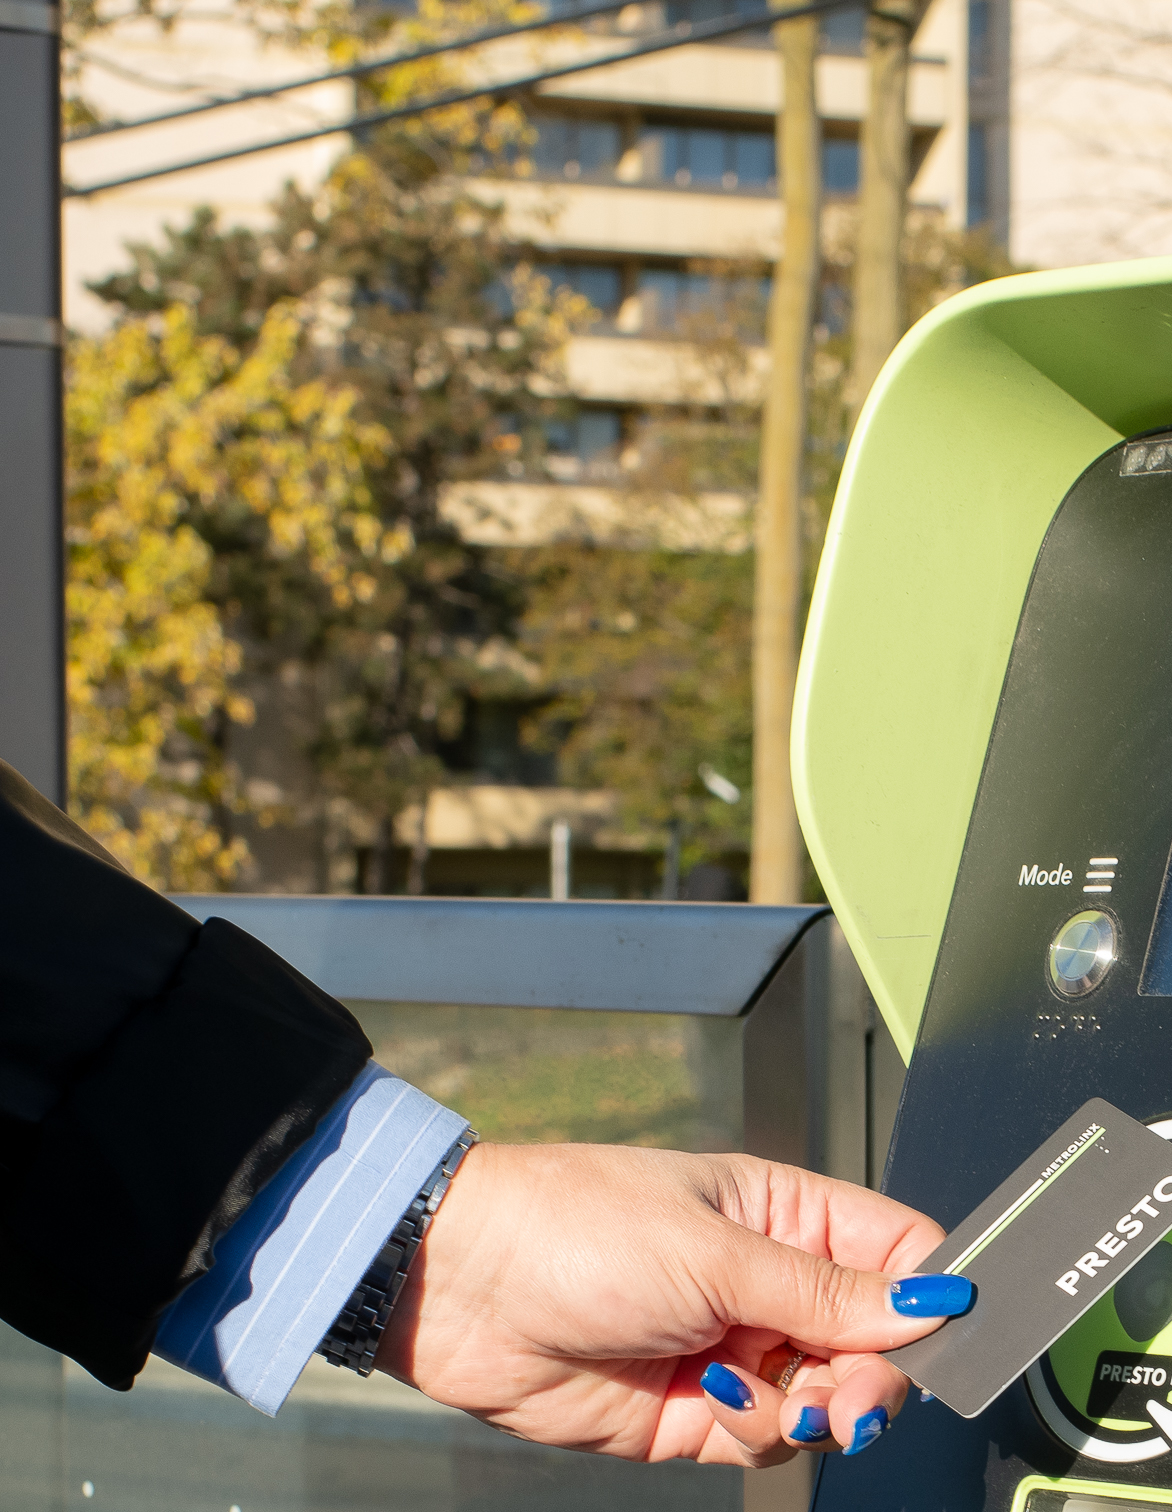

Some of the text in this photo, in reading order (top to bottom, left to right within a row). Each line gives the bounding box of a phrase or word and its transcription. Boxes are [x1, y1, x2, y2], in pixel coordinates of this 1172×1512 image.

[1018, 862, 1073, 887] Mode
[1040, 1122, 1100, 1180] METROLINX
[1099, 1363, 1167, 1387] PRESTO
